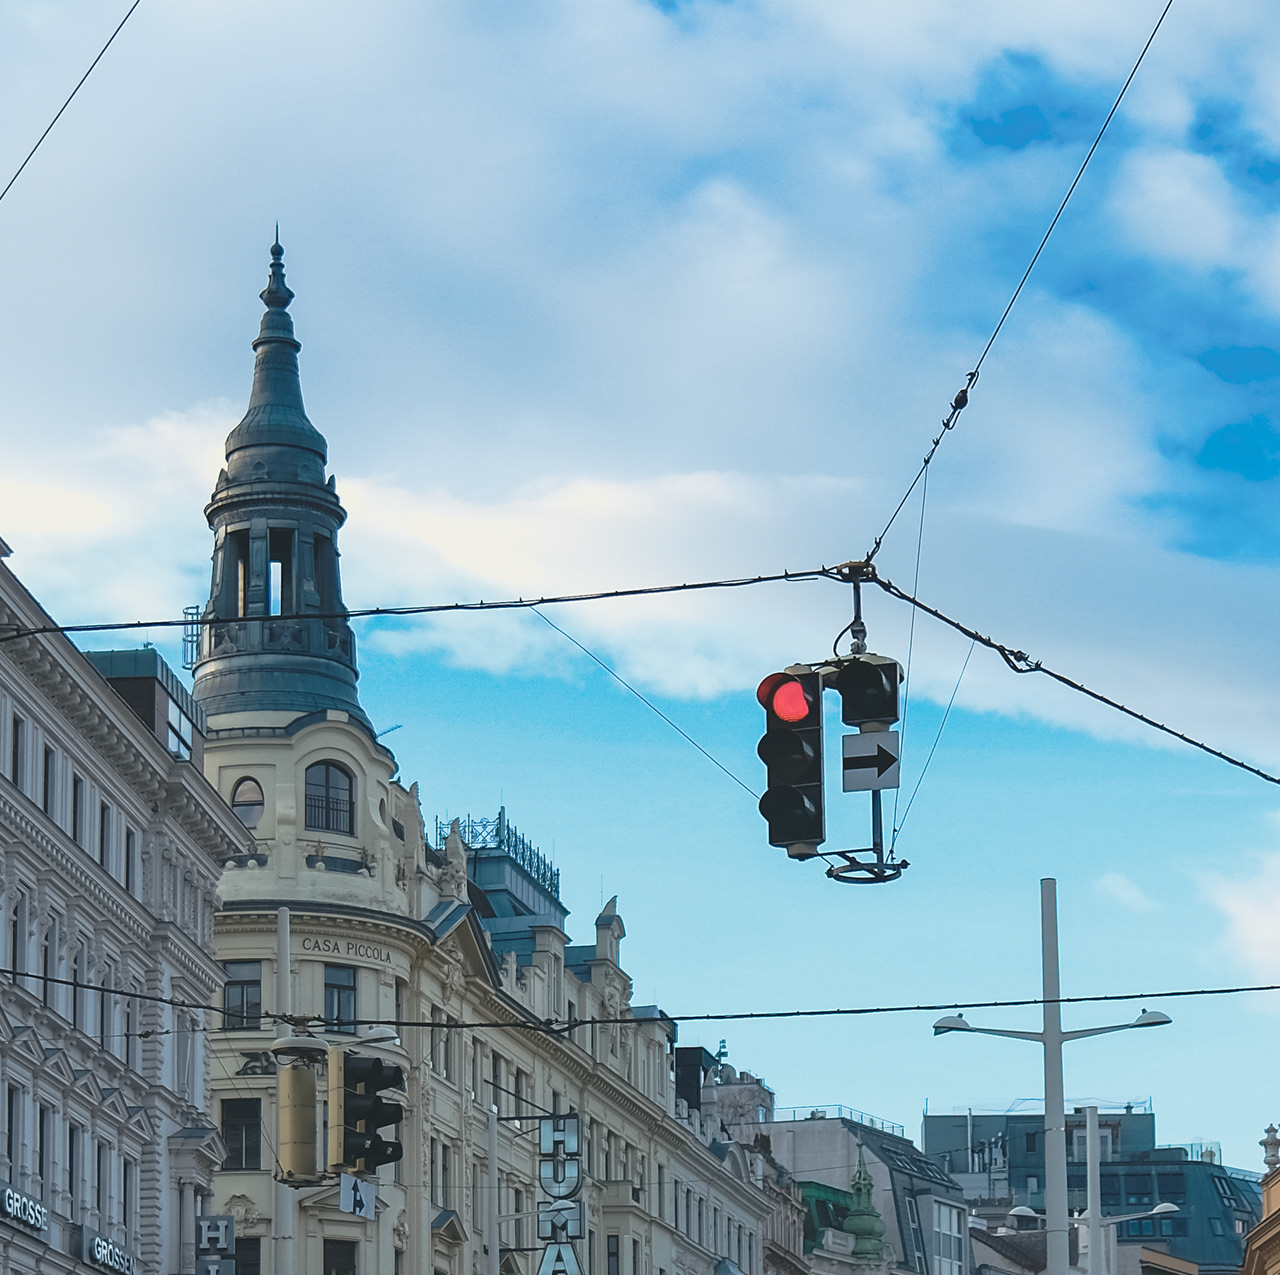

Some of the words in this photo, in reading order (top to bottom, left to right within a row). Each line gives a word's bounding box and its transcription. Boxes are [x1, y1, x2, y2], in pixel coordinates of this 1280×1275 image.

[302, 937, 341, 954] CASA
[346, 941, 392, 964] PICCOLA
[4, 1187, 49, 1232] GROSSE
